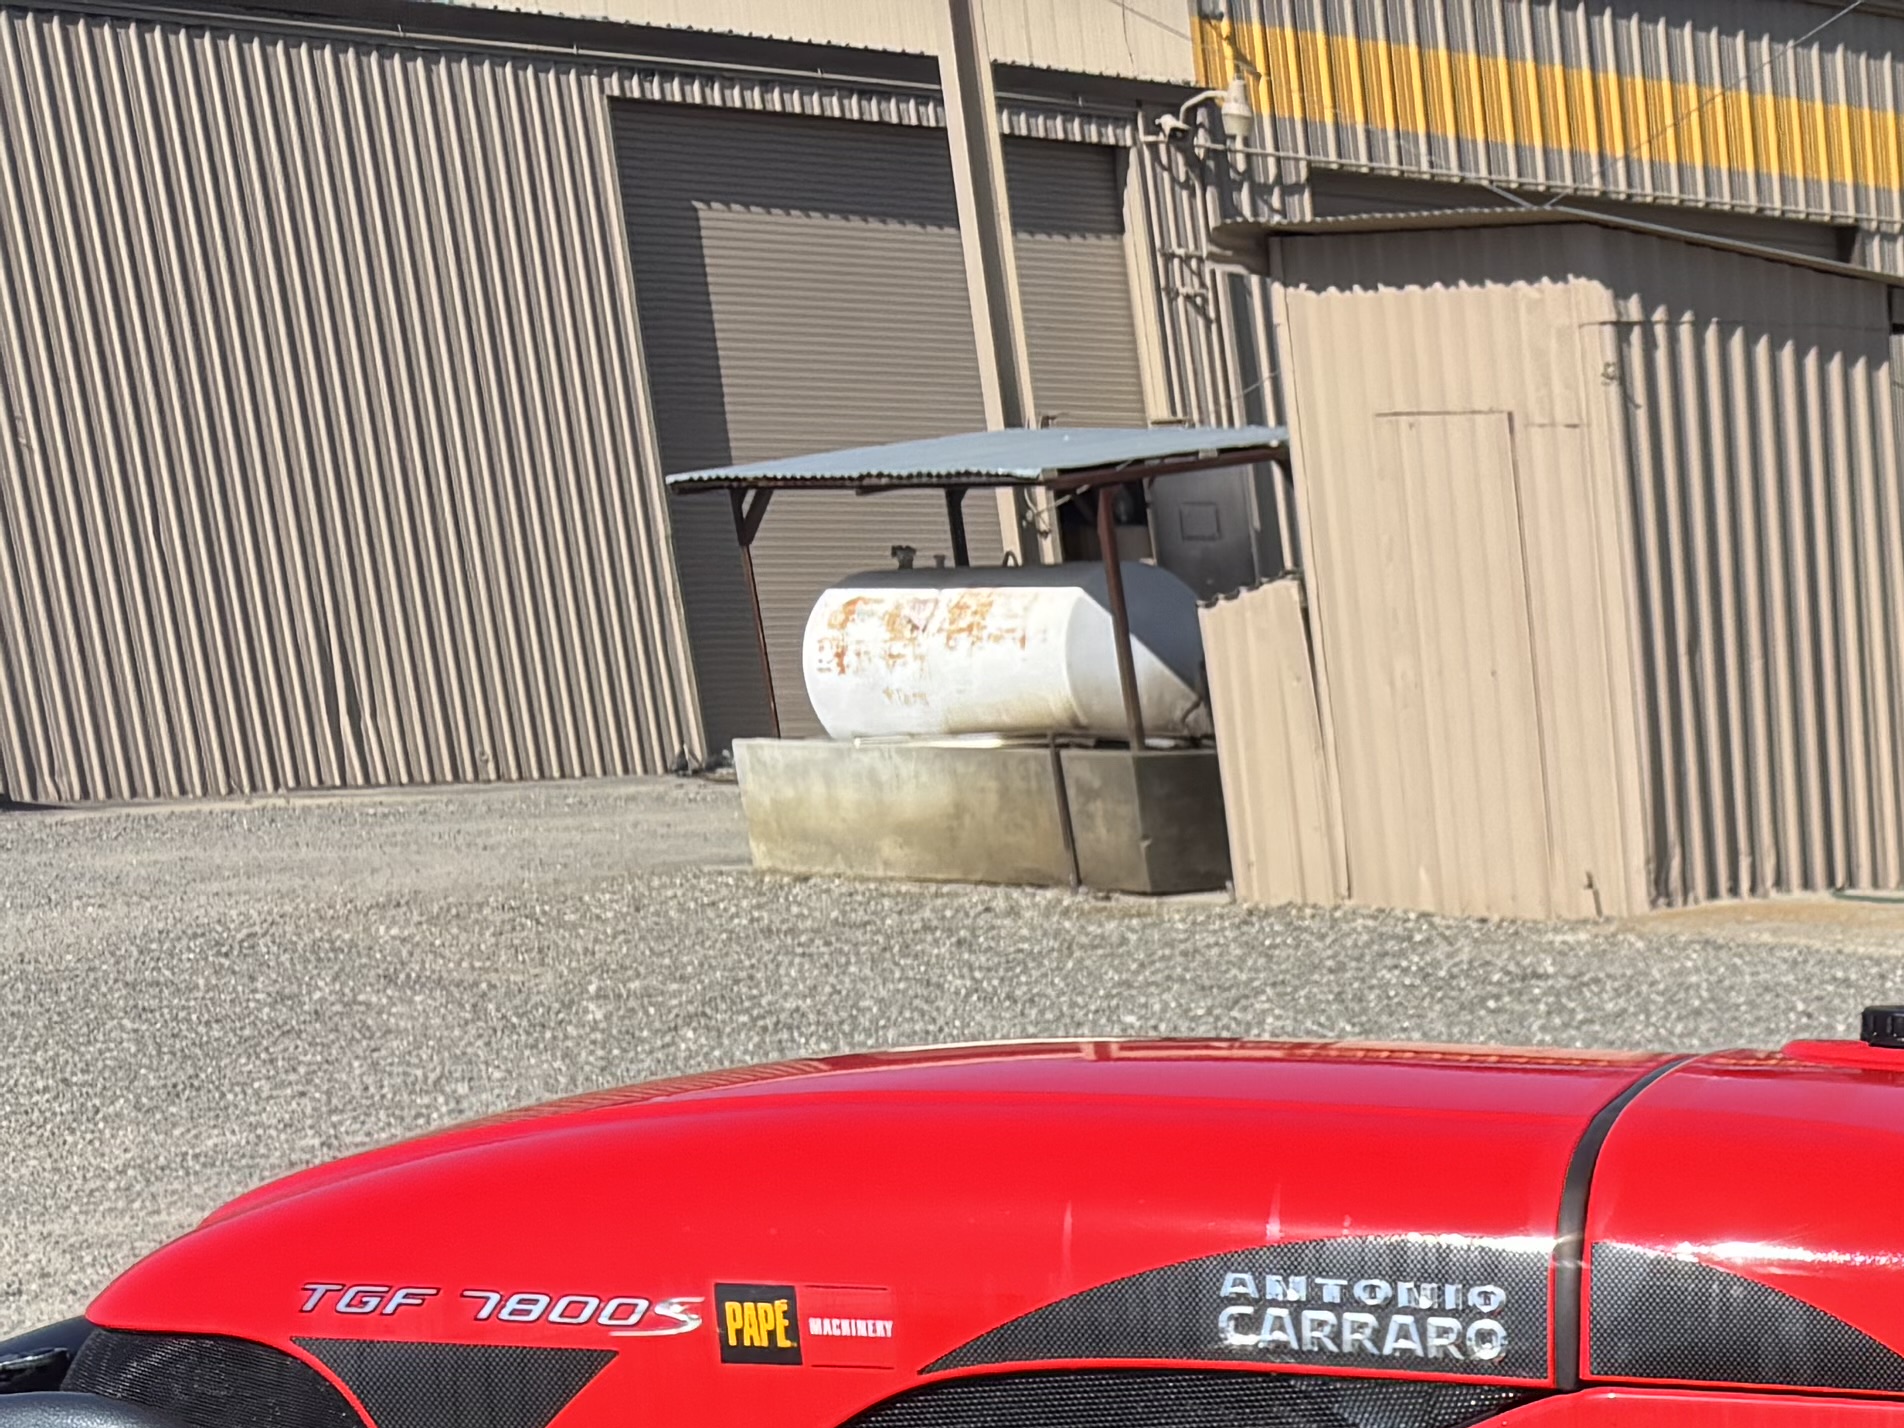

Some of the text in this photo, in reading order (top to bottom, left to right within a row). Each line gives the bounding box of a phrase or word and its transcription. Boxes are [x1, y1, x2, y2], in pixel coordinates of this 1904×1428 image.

[298, 1284, 705, 1337] TGF 7800S
[1219, 1272, 1507, 1312] ANTONIO
[808, 1317, 893, 1338] MACHINERY
[1218, 1305, 1508, 1360] CARRARO
